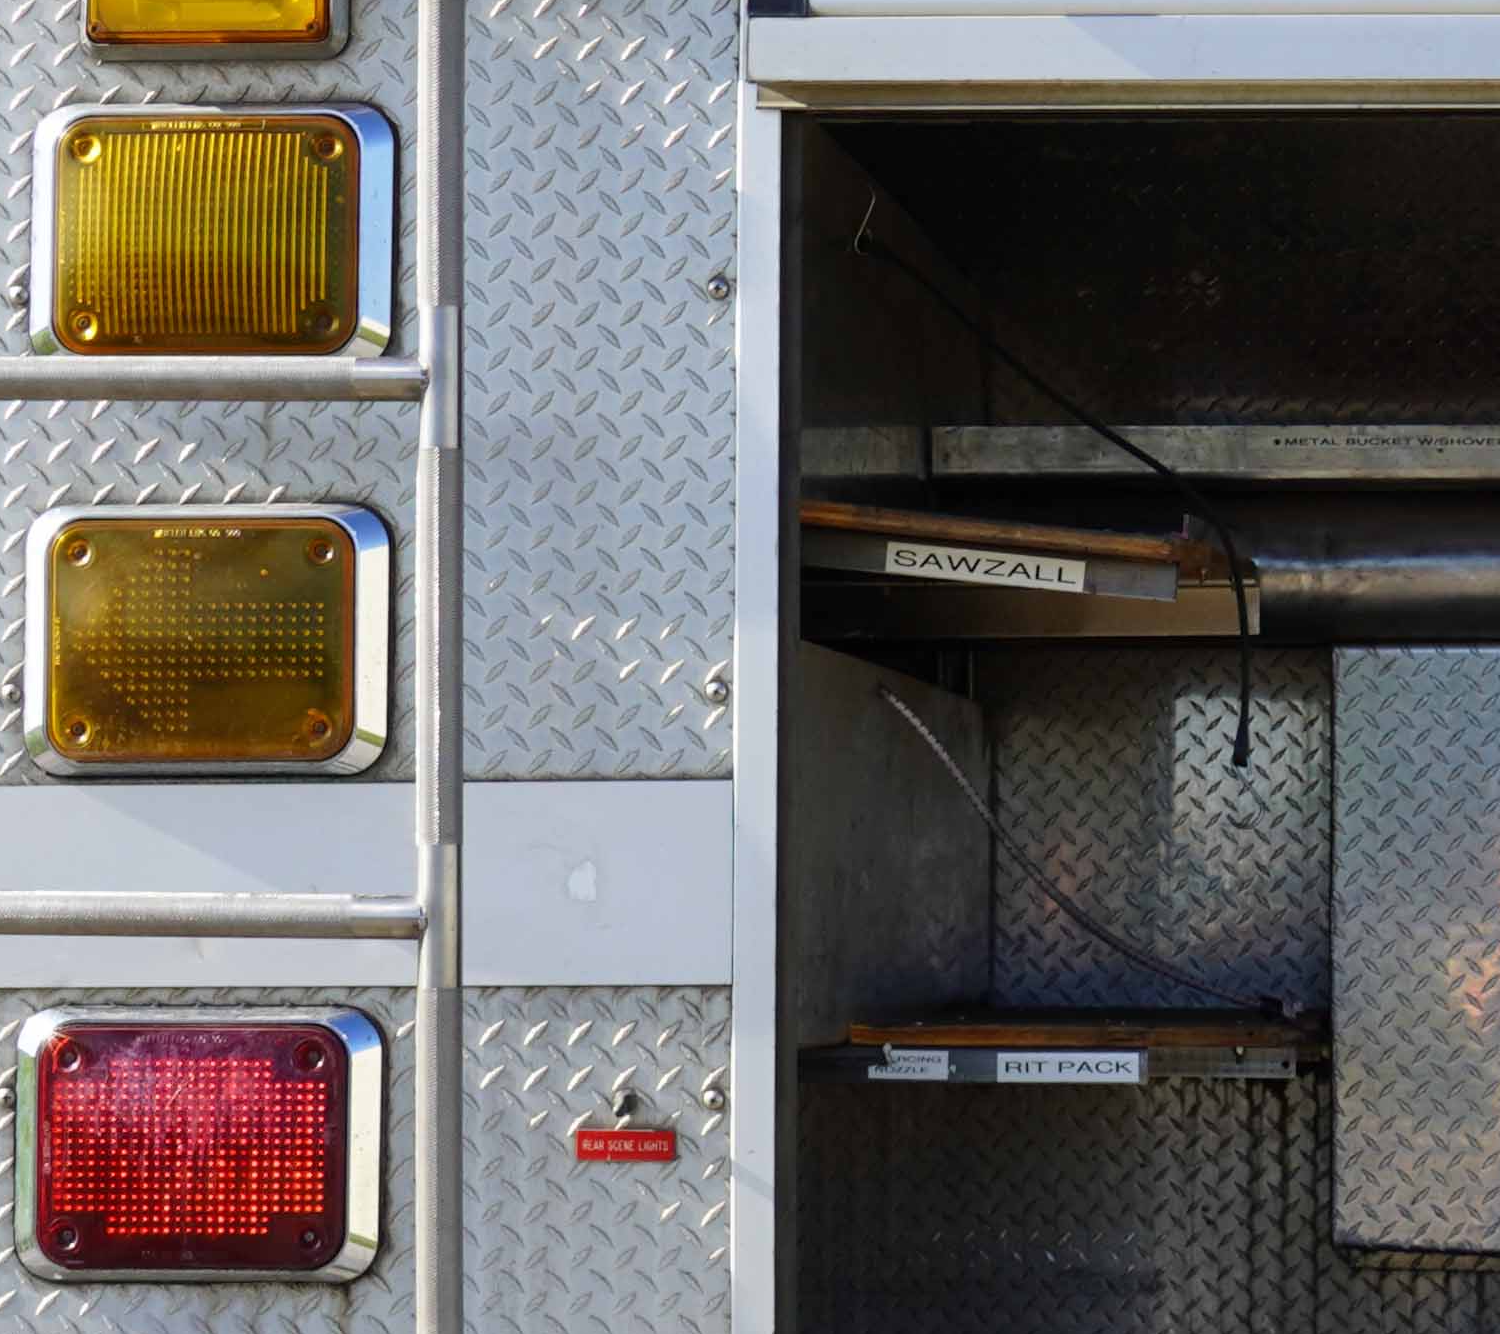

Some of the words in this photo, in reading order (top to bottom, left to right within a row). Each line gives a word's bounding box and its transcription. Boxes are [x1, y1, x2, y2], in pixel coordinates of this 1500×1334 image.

[1284, 437, 1338, 447] METAL
[1346, 437, 1414, 447] BUCKET
[893, 549, 1077, 584] SAWZALL
[1005, 1060, 1049, 1074] RIT
[1058, 1060, 1133, 1074] PACK
[581, 1138, 605, 1151] REAR
[607, 1138, 636, 1152] SCENE
[638, 1138, 669, 1152] LIGHTS
